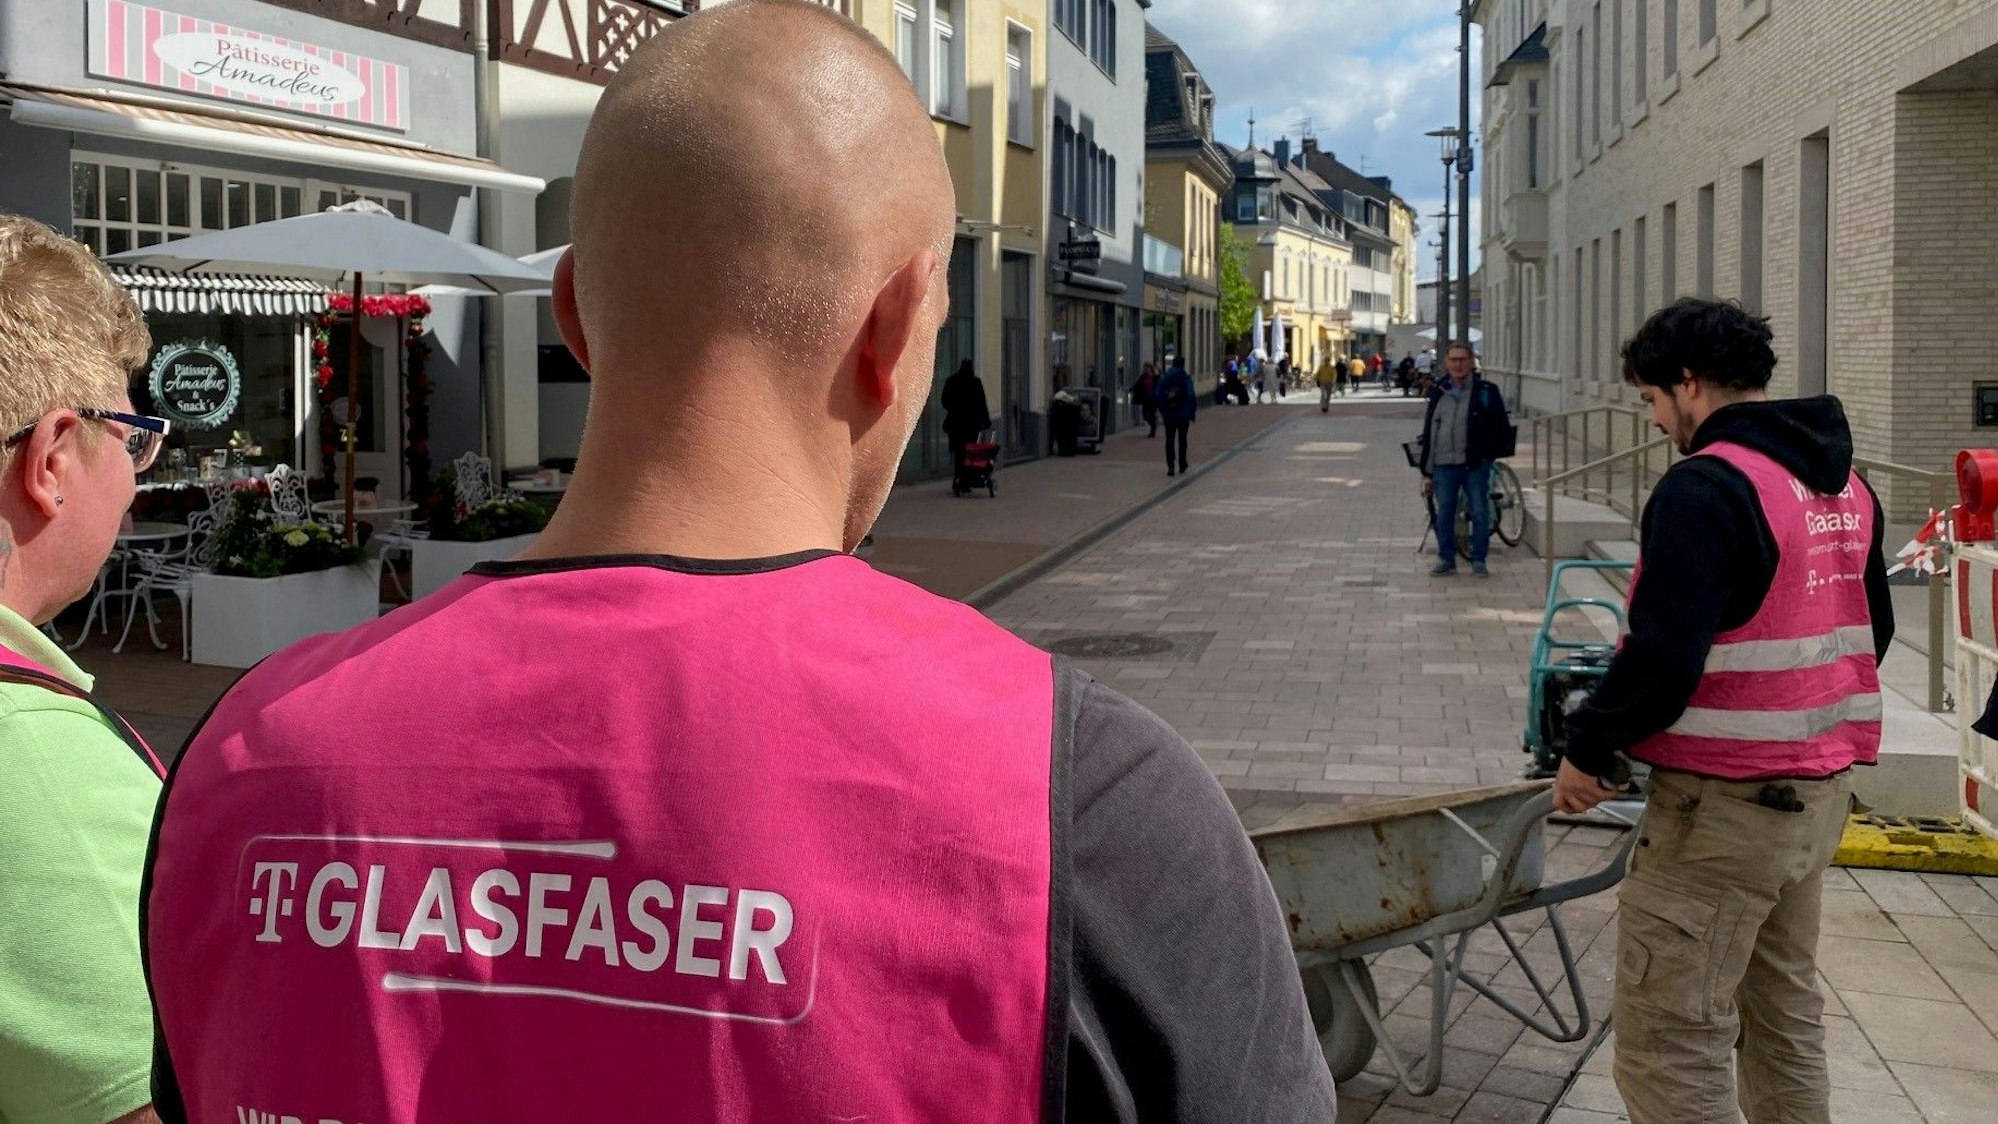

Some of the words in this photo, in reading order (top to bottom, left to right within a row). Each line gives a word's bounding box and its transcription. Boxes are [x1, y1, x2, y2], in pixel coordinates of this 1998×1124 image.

[188, 55, 339, 101] Amadeus
[216, 39, 320, 76] Pâtisserie
[164, 374, 226, 392] Amadeus
[305, 861, 794, 985] GLASFASER
